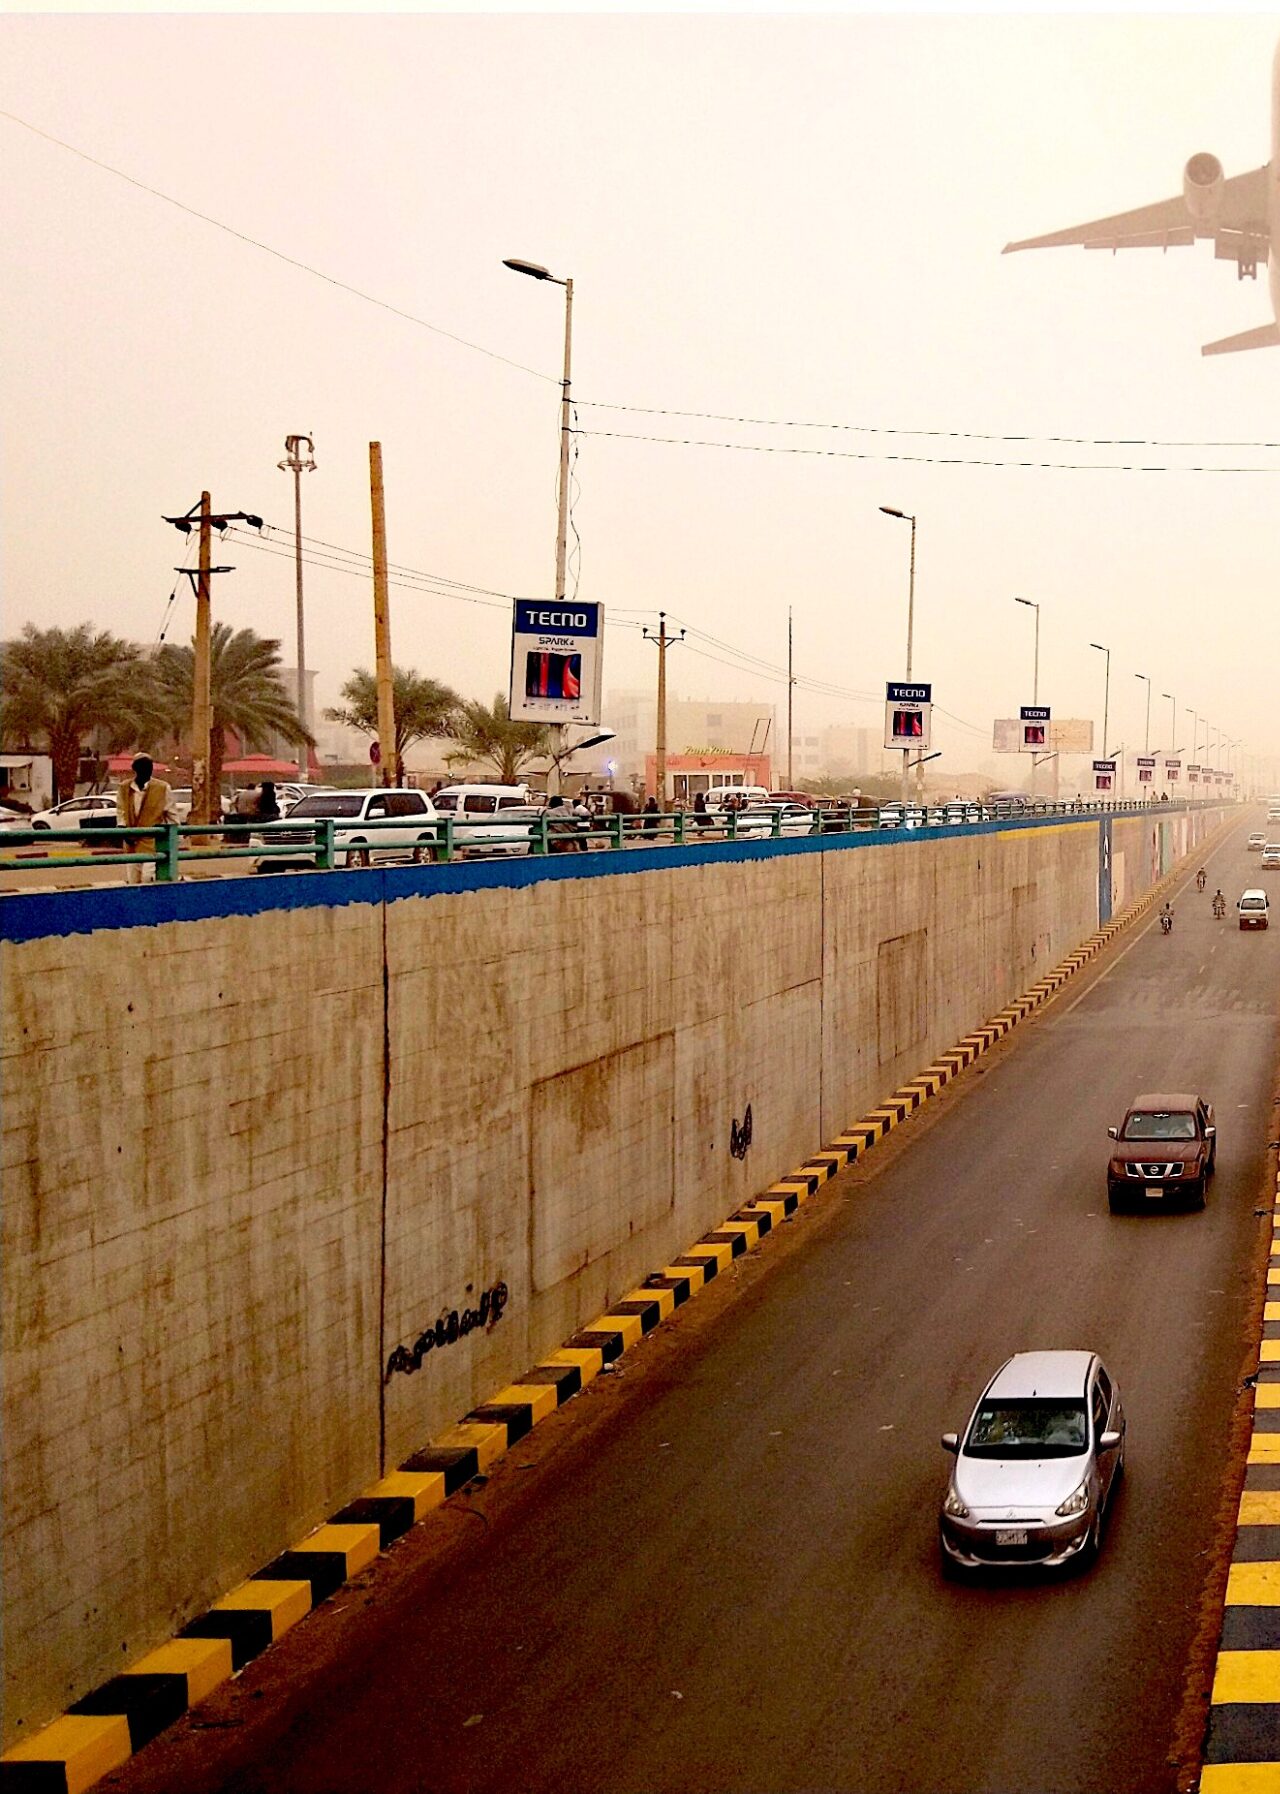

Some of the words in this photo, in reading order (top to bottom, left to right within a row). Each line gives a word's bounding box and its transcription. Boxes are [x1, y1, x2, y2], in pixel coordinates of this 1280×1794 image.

[526, 611, 587, 627] TECNO
[893, 688, 926, 698] TECNO
[1024, 710, 1047, 718] TECNO
